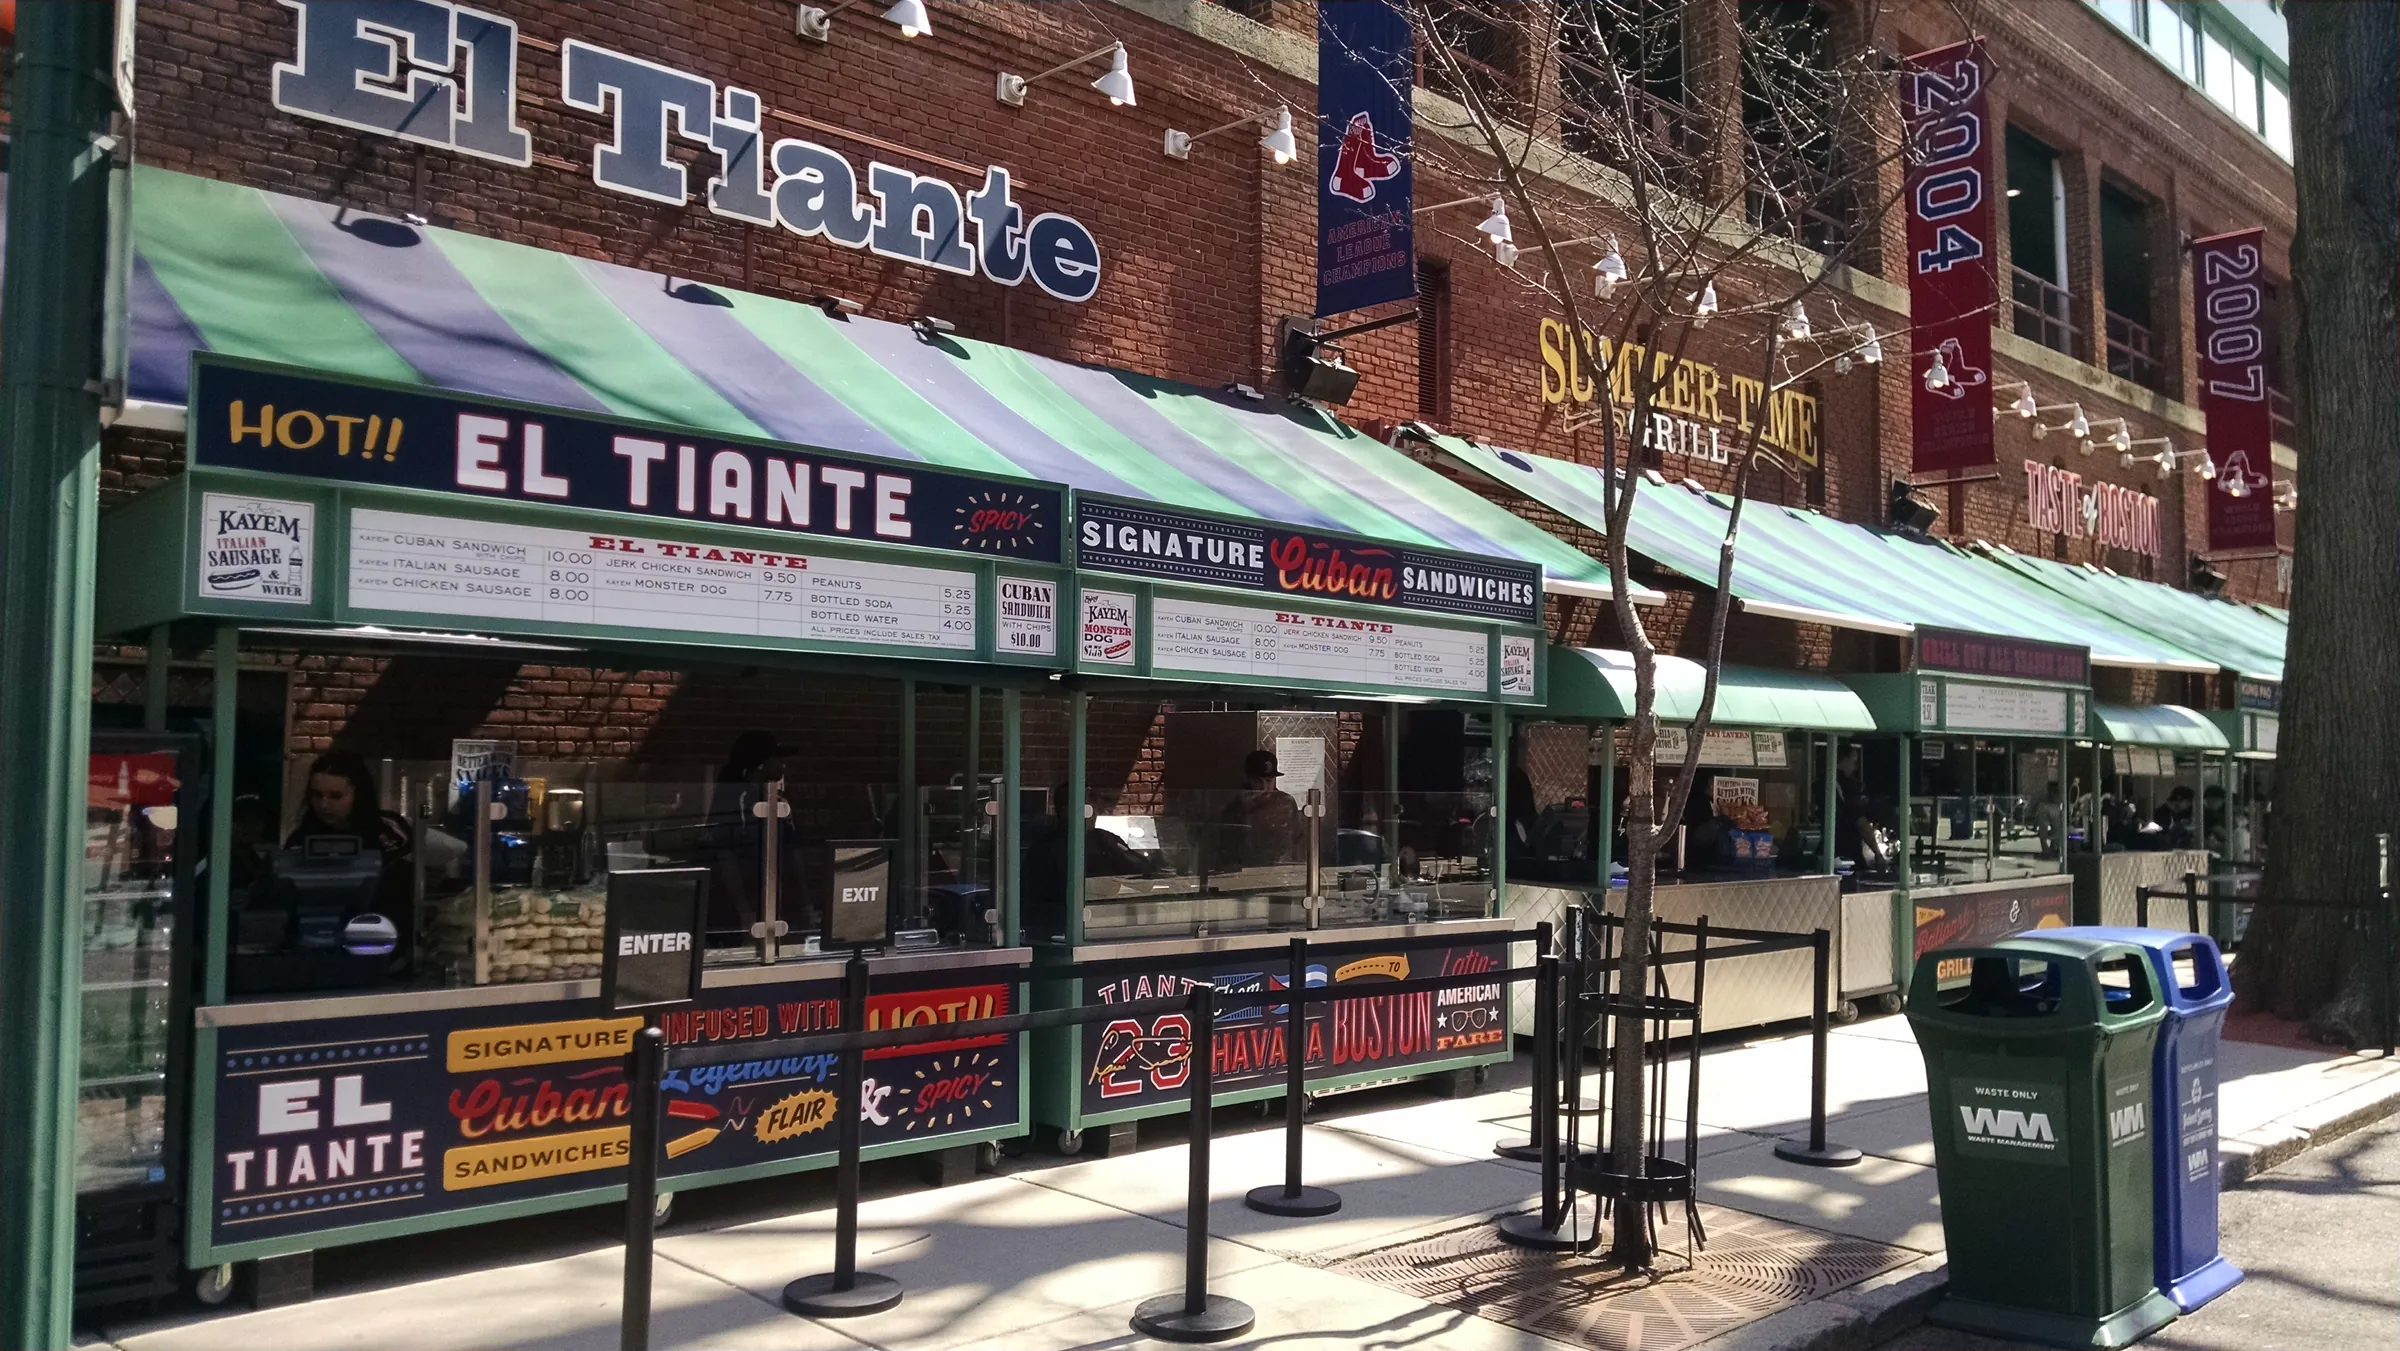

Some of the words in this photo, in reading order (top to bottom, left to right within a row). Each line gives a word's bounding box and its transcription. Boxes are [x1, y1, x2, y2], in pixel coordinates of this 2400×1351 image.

[272, 0, 532, 168] El
[562, 38, 1101, 301] Tiante
[1915, 59, 1983, 274] 2004
[1327, 210, 1401, 245] AMERICAN
[1336, 233, 1391, 263] LEAGUE
[1323, 251, 1406, 287] CHAMPIONS
[2205, 244, 2263, 402] 2007
[229, 400, 404, 462] HOT!!
[1629, 410, 1729, 465] GRILL
[456, 411, 570, 497] EL
[612, 434, 913, 540] TIANTE
[2024, 459, 2083, 539] TASTE
[2083, 484, 2098, 536] of
[2098, 481, 2161, 558] BOSTON
[218, 510, 301, 542] KAYEM
[968, 507, 1033, 534] SPICY
[217, 537, 266, 549] ITALIAN
[359, 534, 390, 543] KAYEM
[394, 535, 446, 549] CUBAN
[452, 540, 526, 556] SANDWICH
[547, 550, 592, 565] 10.00
[589, 536, 645, 553] EL
[657, 543, 808, 570] TIANTE
[208, 548, 282, 567] SAUSAGE
[500, 554, 526, 562] CHIPS
[1082, 520, 1264, 569] SIGNATURE
[1270, 535, 1398, 600] Cuban
[1403, 566, 1534, 606] SANDWICHES
[268, 570, 280, 580] &
[359, 559, 389, 567] KAYEM
[393, 558, 447, 571] ITALIAN
[454, 563, 521, 579] SAUSAGE
[549, 570, 590, 584] 8.00
[606, 558, 637, 569] JERK
[641, 561, 691, 574] CHICKEN
[696, 567, 752, 580] SANDWICH
[763, 571, 797, 585] 9.50
[261, 585, 302, 596] WATER
[358, 578, 388, 586] KAYEM
[392, 577, 459, 592] CHICKEN
[465, 583, 532, 597] SAUSAGE
[549, 588, 589, 602] 8.00
[635, 579, 694, 592] MONSTER
[701, 584, 727, 595] DOG
[764, 589, 793, 602] 7.75
[812, 577, 862, 590] PEANUTS
[944, 588, 971, 600] 5.25
[1002, 583, 1051, 603] CUBAN
[811, 594, 860, 606] BOTTLED
[865, 598, 893, 609] SODA
[944, 604, 971, 616] 5.25
[1002, 601, 1052, 620] SANDWICH
[1089, 605, 1128, 626] KAYEM
[811, 610, 860, 622] BOTTLED
[864, 616, 898, 625] WATER
[943, 620, 972, 631] 4.00
[1002, 621, 1022, 629] WITH
[1026, 622, 1052, 633] CHIPS
[1084, 624, 1132, 636] MONSTER
[1175, 615, 1201, 625] CUBAN
[1205, 617, 1243, 628] SANDWICH
[1253, 623, 1277, 634] 10.00
[1275, 613, 1305, 624] EL
[1311, 616, 1393, 634] TIANTE
[830, 627, 861, 636] PRICES
[864, 629, 898, 639] INCLUDE
[901, 632, 925, 640] SALES
[1010, 632, 1041, 649] $10.00
[1085, 633, 1113, 643] DOG
[1175, 632, 1203, 642] ITALIAN
[1206, 635, 1241, 645] SAUSAGE
[1254, 638, 1276, 648] 8.00
[1283, 628, 1300, 636] JERK
[1302, 630, 1330, 639] CHICKEN
[1332, 632, 1362, 642] SANDWICH
[1395, 639, 1423, 649] PEANUTS
[1084, 644, 1102, 657] $7.75
[1174, 646, 1209, 656] CHICKEN
[1212, 648, 1246, 659] SAUSAGE
[1254, 650, 1276, 661] 8.00
[1298, 643, 1331, 653] MONSTER
[1334, 646, 1349, 654] DOG
[1369, 648, 1385, 658] 7.75
[1394, 651, 1422, 661] BOTTLED
[1424, 654, 1441, 662] SODA
[1504, 645, 1530, 661] KAYEM
[1394, 663, 1422, 672] BOTTLED
[1424, 666, 1443, 674] WATER
[1501, 665, 1524, 676] SAUSAGE
[1722, 730, 1750, 739] TAVERN
[1717, 787, 1738, 798] BETTER
[1740, 787, 1755, 796] WITH
[842, 886, 879, 903] EXIT
[2010, 899, 2021, 923] &
[618, 932, 692, 956] ENTER
[1389, 962, 1400, 973] TO
[1937, 957, 1972, 979] GRILL
[1098, 974, 1196, 1005] TIANT
[1437, 983, 1501, 1007] AMERICAN
[660, 1005, 769, 1046] INFUSED
[778, 999, 840, 1034] WITH
[1333, 991, 1432, 1065] BOSTON
[463, 1029, 628, 1060] SIGNATURE
[1212, 1022, 1326, 1076] HAVAA
[1437, 1029, 1503, 1051] FARE
[1102, 1014, 1192, 1098] 23
[861, 1078, 891, 1126] &
[914, 1072, 990, 1113] SPICY
[1975, 1087, 2009, 1098] WASTE
[2012, 1090, 2038, 1100] ONLY
[259, 1074, 392, 1136] EL
[449, 1078, 630, 1138] Cuban
[767, 1097, 827, 1135] FLAIR
[1960, 1106, 2055, 1142] WM
[1968, 1135, 1995, 1144] WASTE
[1997, 1139, 2055, 1150] MANAGEMENT
[227, 1130, 425, 1192] TIANTE
[454, 1139, 630, 1179] SANDWICHES
